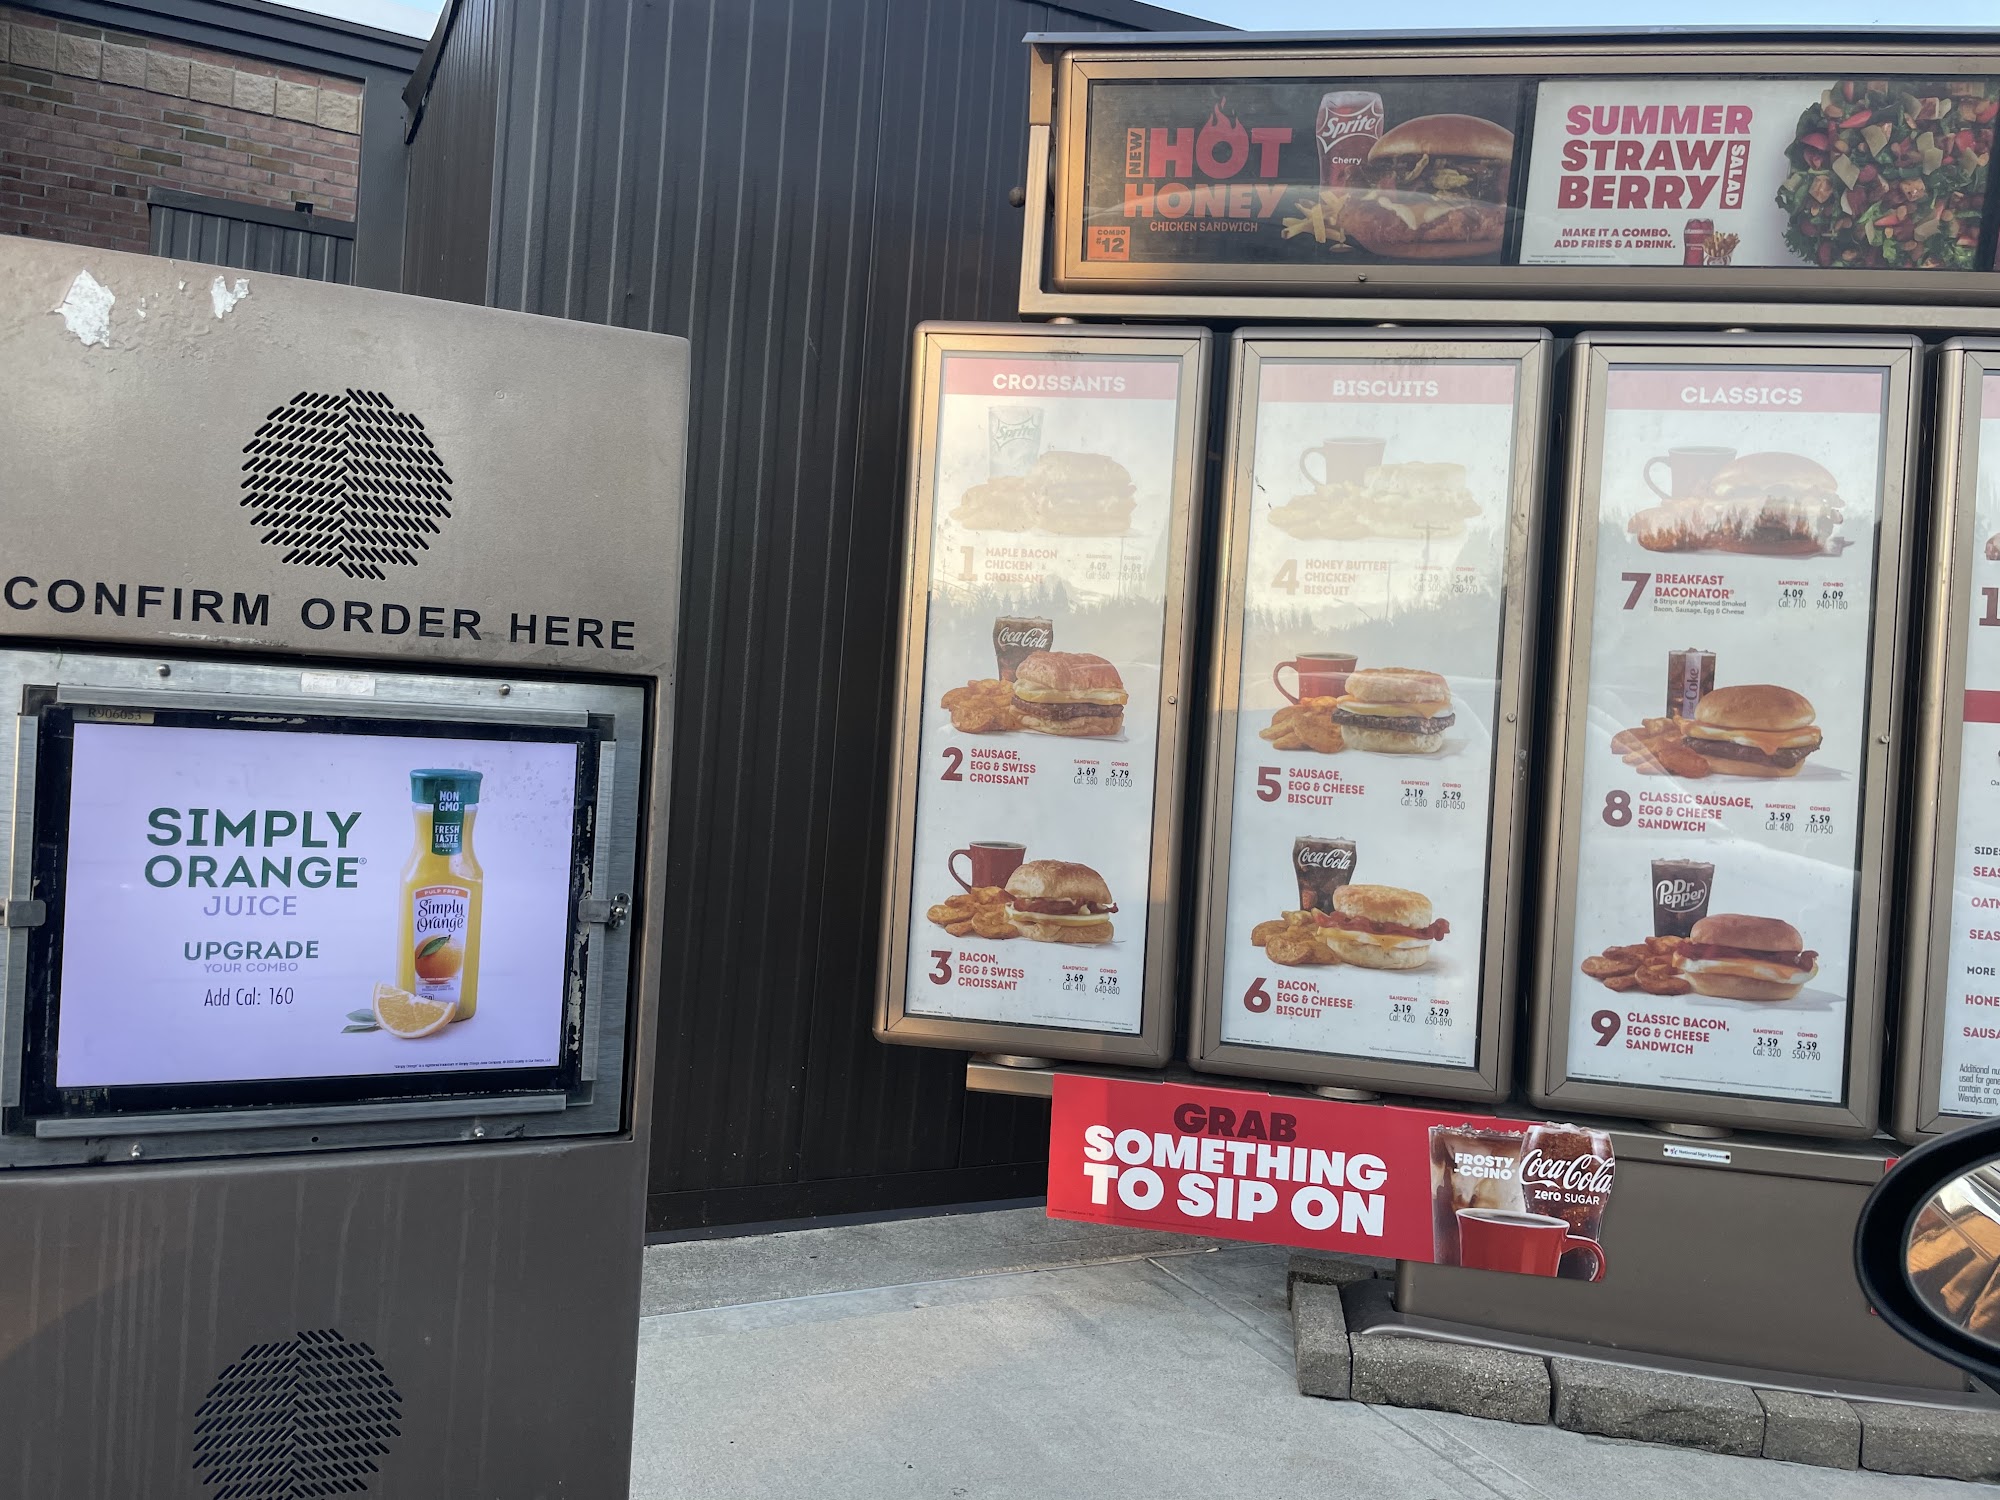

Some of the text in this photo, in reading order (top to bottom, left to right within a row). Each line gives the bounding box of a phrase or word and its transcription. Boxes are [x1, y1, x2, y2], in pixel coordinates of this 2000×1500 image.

[1322, 115, 1376, 138] Sprite
[1565, 105, 1753, 135] SUMMER
[1148, 111, 1293, 179] HOT
[1129, 132, 1142, 174] NEW
[1561, 140, 1729, 171] STRAW
[1332, 157, 1361, 165] Cherry
[1724, 143, 1747, 207] SALAD
[1557, 175, 1720, 210] BERRY
[1124, 183, 1288, 218] HONEY
[1150, 221, 1258, 232] CHICKEN SANDWICH
[1562, 228, 1671, 237] MAKE IT A COMBO.
[1096, 238, 1124, 252] #12
[1554, 240, 1676, 248] ADD FRIES & A DRINK.
[992, 374, 1126, 392] CROISSANTS
[1333, 380, 1439, 397] BISCUITS
[1681, 387, 1803, 405] CLASSICS
[997, 421, 1039, 440] Sprite
[986, 548, 1058, 560] MAPLE BACON
[958, 546, 978, 582] 1
[985, 560, 1032, 571] CHICKEN
[1305, 559, 1387, 571] HONEY BUTTER
[984, 572, 1044, 584] CROISSANT
[1271, 559, 1299, 595] 4
[1305, 573, 1356, 583] CHICKEN
[1656, 573, 1724, 585] BREAKFAST
[1304, 585, 1349, 596] BISCUIT
[1621, 572, 1651, 610] 7
[1783, 589, 1843, 599] 4.09 6.09
[1778, 598, 1791, 608] Cal:
[1793, 599, 1807, 609] 710
[4, 575, 635, 651] CONFIRM ORDER HERE
[998, 626, 1050, 649] Coca-Cola
[1685, 668, 1699, 700] Coke
[971, 749, 1021, 762] SAUSAGE,
[941, 747, 963, 782] 2
[971, 761, 1036, 774] EGG & SWISS
[970, 773, 1029, 786] CROISSANT
[1077, 768, 1129, 778] 3.69 5.79
[1289, 768, 1343, 782] SAUSAGE,
[1074, 776, 1132, 788] Cal: 580 810-1050
[1257, 766, 1282, 802] 5
[1288, 781, 1364, 795] EGG & CHEESE
[440, 791, 459, 801] NON
[1288, 793, 1333, 806] BISCUIT
[1405, 788, 1461, 800] 3.19 5.29
[1640, 791, 1753, 810] CLASSIC SAUSAGE,
[439, 802, 459, 811] GMO
[1401, 797, 1465, 810] Cal: 580 810-1050
[1602, 790, 1632, 827] 8
[1639, 805, 1722, 820] EGG & CHEESE
[1770, 812, 1830, 824] 3.59 5.59
[147, 807, 362, 848] SIMPLY
[435, 825, 459, 833] FRESH
[1638, 818, 1706, 832] SANDWICH
[1765, 821, 1833, 835] Cal: 480 710-950
[435, 834, 458, 843] TASTE
[1298, 847, 1352, 870] Coca-Cola
[1656, 879, 1705, 908] Pepper
[1673, 879, 1694, 893] Dr
[203, 896, 297, 916] JUICE
[418, 899, 465, 918] Simply
[417, 916, 465, 933] Orange
[184, 941, 319, 960] UPGRADE
[960, 952, 999, 964] BACON,
[204, 962, 298, 973] YOUR COMBO
[929, 950, 952, 985] 3
[959, 964, 1024, 978] EGG & SWISS
[1966, 966, 1996, 976] MORE
[958, 977, 1017, 990] CROISSANT
[1066, 973, 1117, 985] 3.69 5.79
[1277, 979, 1320, 994] BACON,
[1063, 982, 1120, 995] Cal: 410 640-880
[1244, 977, 1271, 1013] 6
[204, 987, 294, 1006] Add Cal: 160
[1277, 992, 1353, 1009] EGG & CHEESE
[1276, 1005, 1321, 1019] BISCUIT
[1394, 1004, 1449, 1017] 3.19 5.29
[1389, 1012, 1452, 1027] Cal: 420 650-890
[1627, 1012, 1730, 1032] CLASSIC BACON,
[1591, 1010, 1621, 1047] 9
[1626, 1026, 1710, 1042] EGG & CHEESE
[1626, 1039, 1694, 1054] SANDWICH
[1757, 1037, 1817, 1051] 3.59 5.59
[1752, 1047, 1820, 1061] Cal: 320 550-790
[1960, 1064, 1989, 1074] Additional
[1173, 1102, 1297, 1142] GRAB
[1084, 1125, 1388, 1191] SOMETHING
[1454, 1153, 1514, 1168] FROSTY
[1519, 1149, 1615, 1194] Coca-Cola
[1083, 1162, 1386, 1237] TO SIP ON
[1534, 1189, 1600, 1205] zero SUGAR
